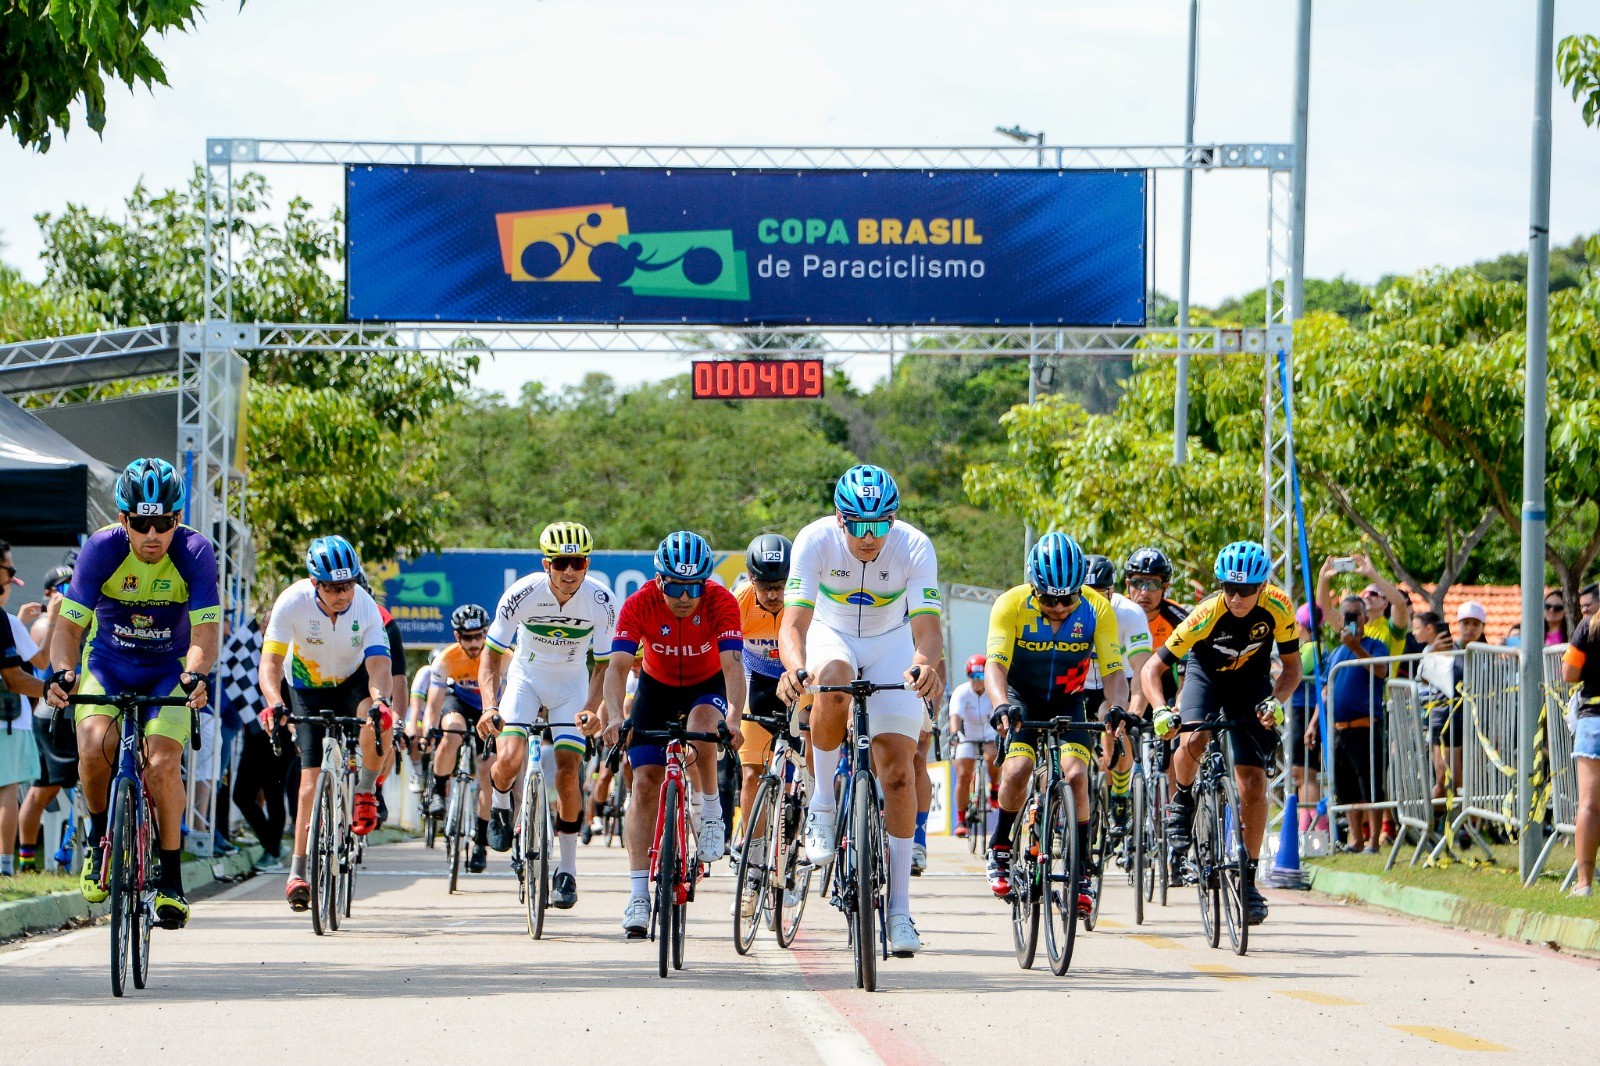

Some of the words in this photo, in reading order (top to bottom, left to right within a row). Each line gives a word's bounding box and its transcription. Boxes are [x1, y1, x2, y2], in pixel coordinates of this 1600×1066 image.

[757, 218, 850, 245] COPA
[857, 218, 983, 245] BRASIL
[757, 254, 791, 278] de
[803, 254, 985, 279] Paraciclismo
[695, 361, 821, 396] 000409
[862, 486, 876, 497] 91
[141, 503, 158, 515] 92
[564, 544, 577, 554] 151
[765, 552, 781, 561] 129
[335, 569, 349, 580] 93
[679, 564, 694, 575] 97
[1229, 571, 1243, 582] 96
[1051, 588, 1066, 596] 99
[391, 606, 444, 620] BRASIL
[717, 630, 742, 639] HILE
[651, 641, 713, 657] CHILE
[1017, 639, 1090, 652] ECUADOR
